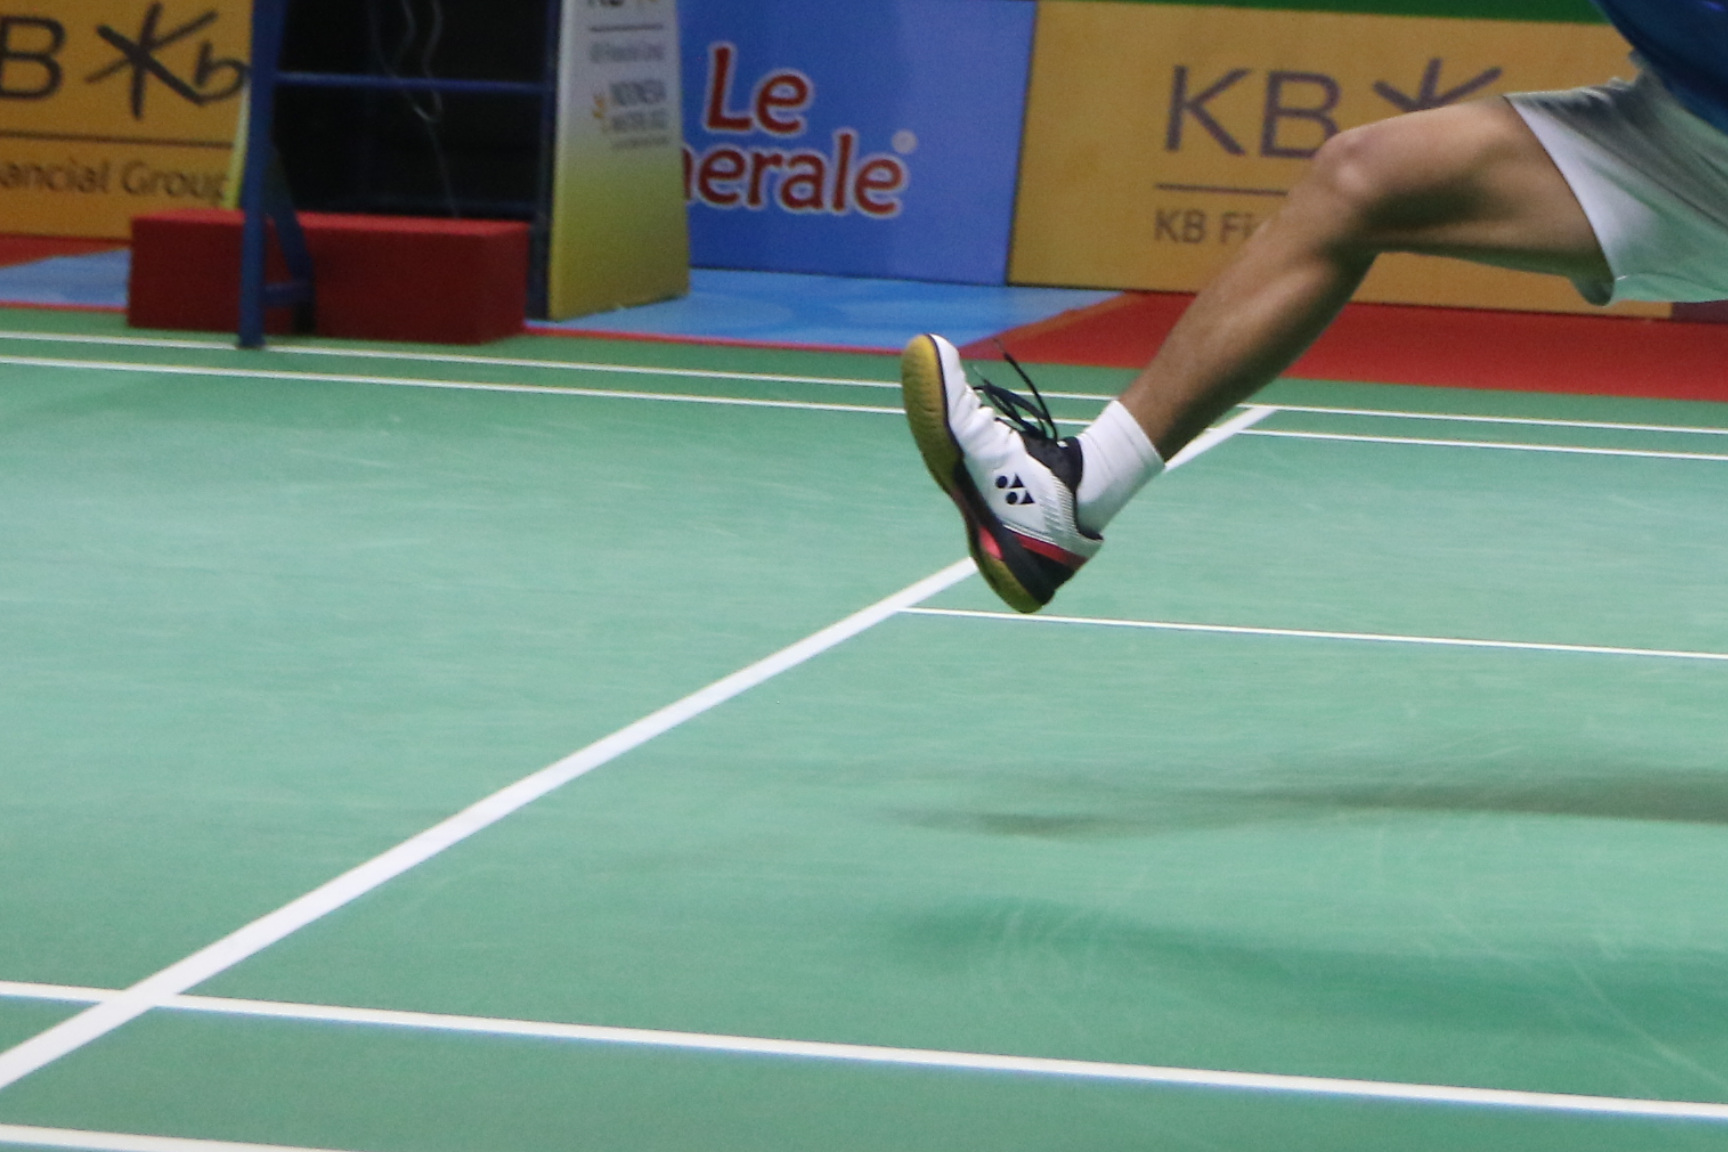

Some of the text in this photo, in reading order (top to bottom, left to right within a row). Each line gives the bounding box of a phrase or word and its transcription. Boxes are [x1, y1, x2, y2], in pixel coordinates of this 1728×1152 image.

[706, 46, 809, 135] Le
[1165, 64, 1341, 160] KB
[1154, 208, 1206, 244] KB
